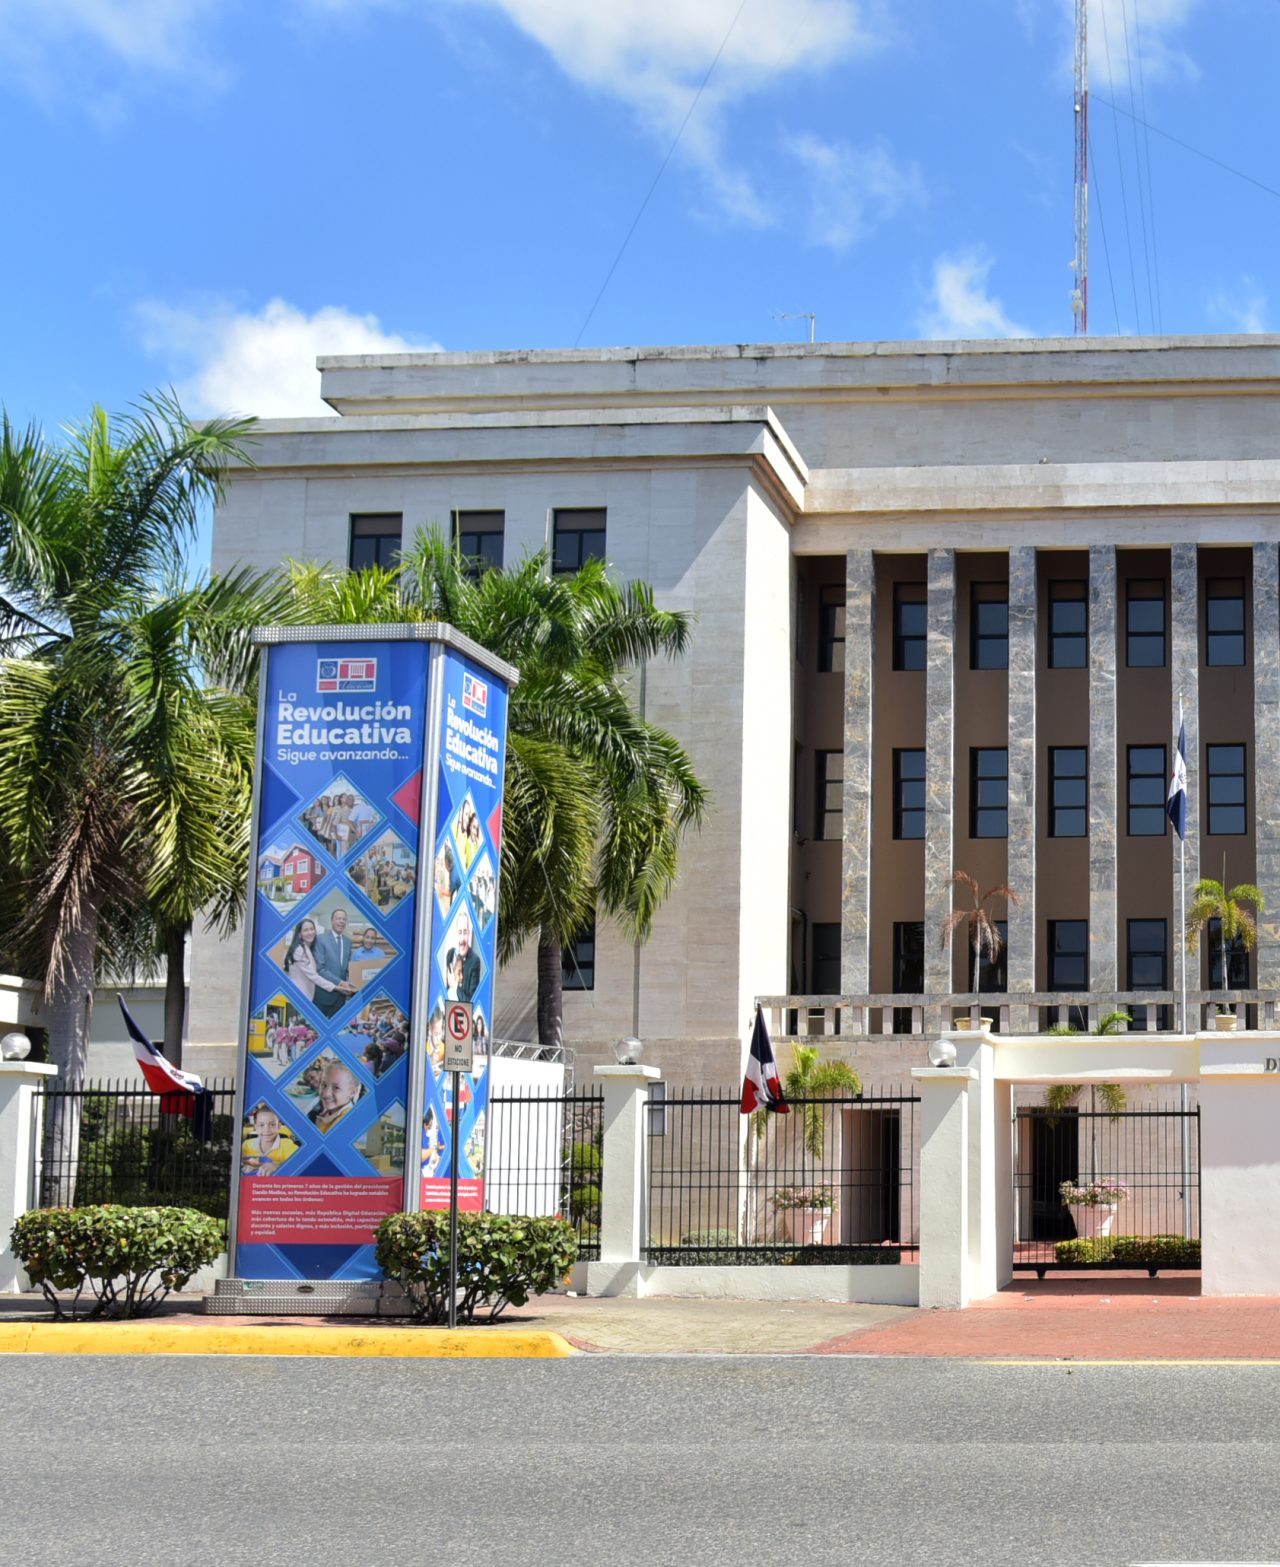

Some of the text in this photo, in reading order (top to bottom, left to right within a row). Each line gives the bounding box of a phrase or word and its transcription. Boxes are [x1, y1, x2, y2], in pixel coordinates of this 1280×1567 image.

[278, 690, 297, 702] La
[447, 692, 456, 708] La
[278, 701, 411, 722] Revolución
[276, 724, 412, 746] Educativa
[447, 706, 499, 752] Revolución
[277, 748, 409, 765] Sigue avanzando...
[446, 728, 498, 775] Educativa
[445, 752, 462, 772] Sigue
[454, 1012, 465, 1034] E
[454, 1044, 462, 1053] NO
[448, 1057, 470, 1067] ESTACIONE
